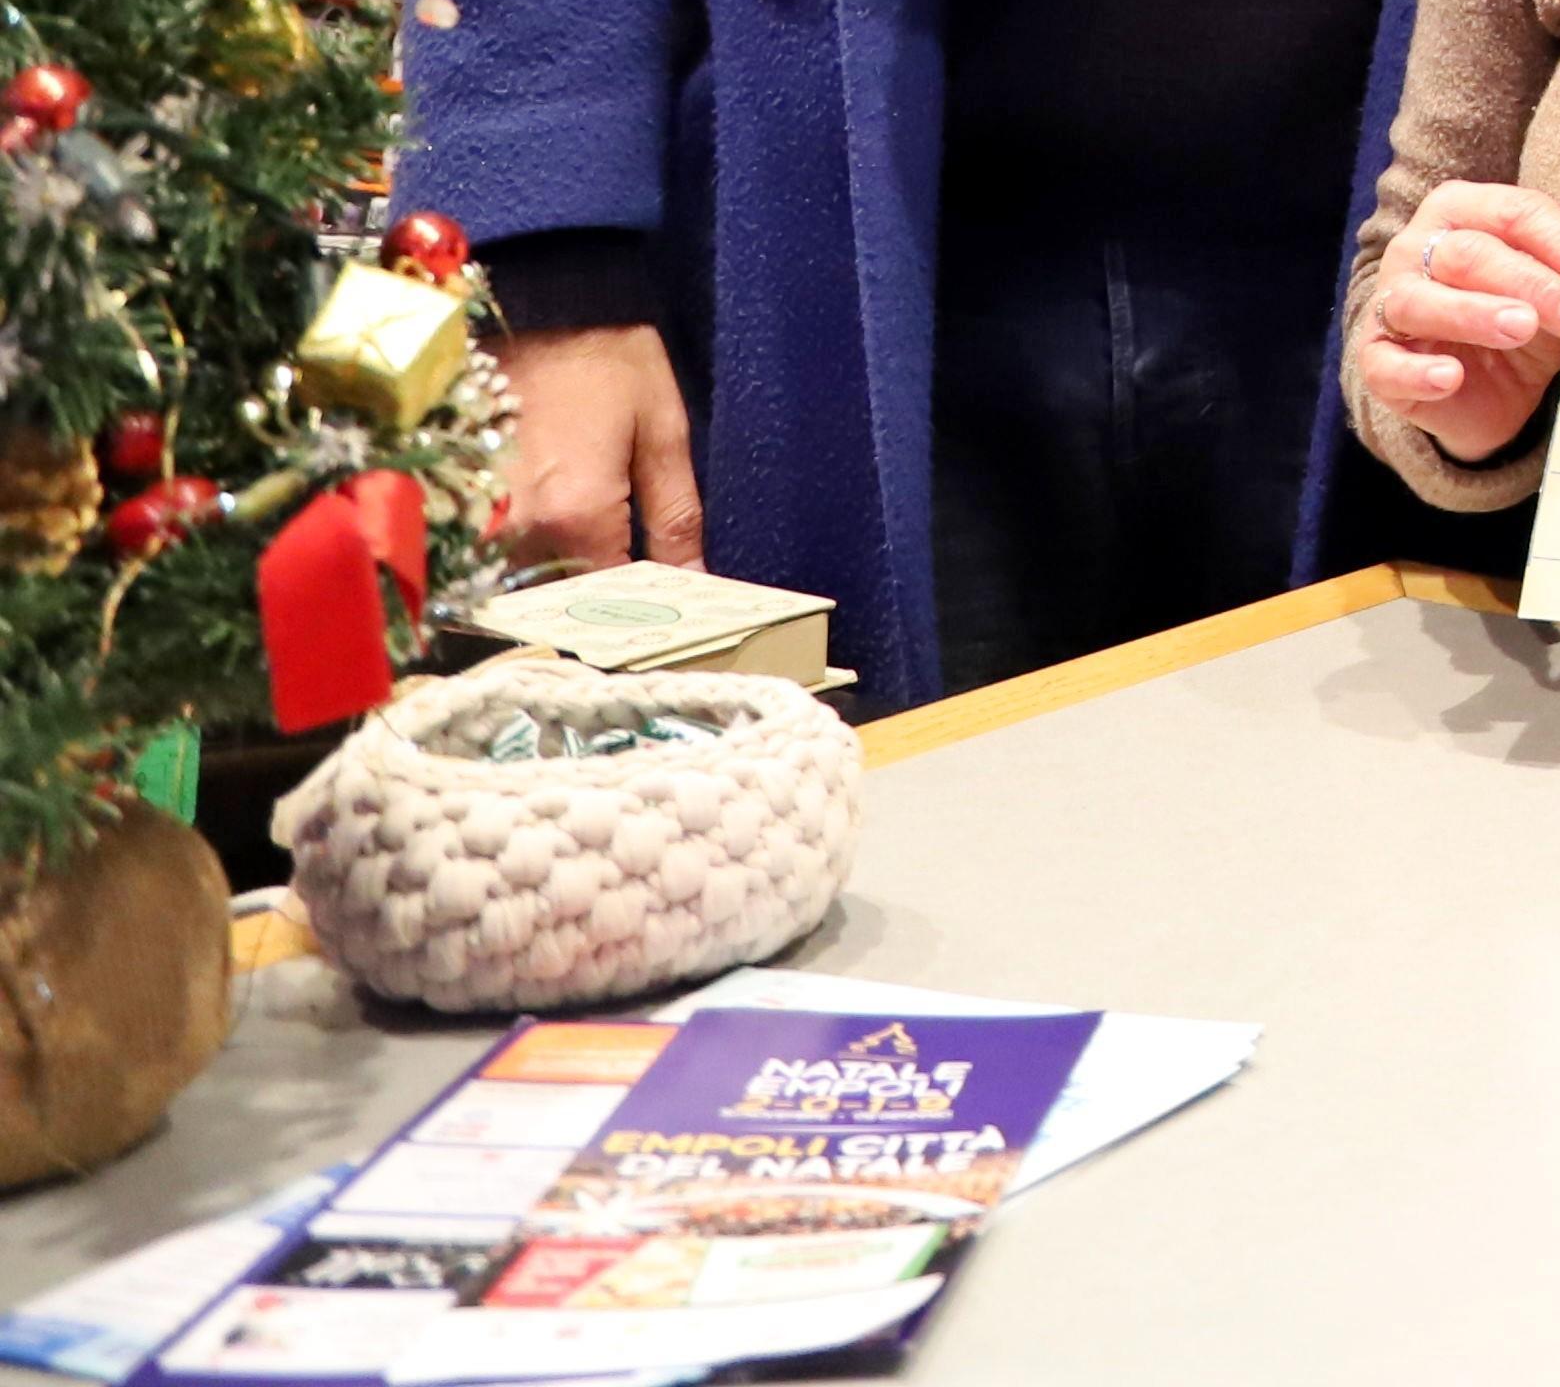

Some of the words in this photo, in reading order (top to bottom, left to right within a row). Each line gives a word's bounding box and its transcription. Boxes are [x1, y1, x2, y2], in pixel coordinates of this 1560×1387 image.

[761, 1057, 974, 1083] NATALE
[746, 1075, 965, 1098] EMPOLI
[601, 1129, 830, 1157] EMPOLI
[838, 1123, 1007, 1157] CITTÀ
[616, 1151, 729, 1180] DEL
[748, 1150, 979, 1180] NATALE
